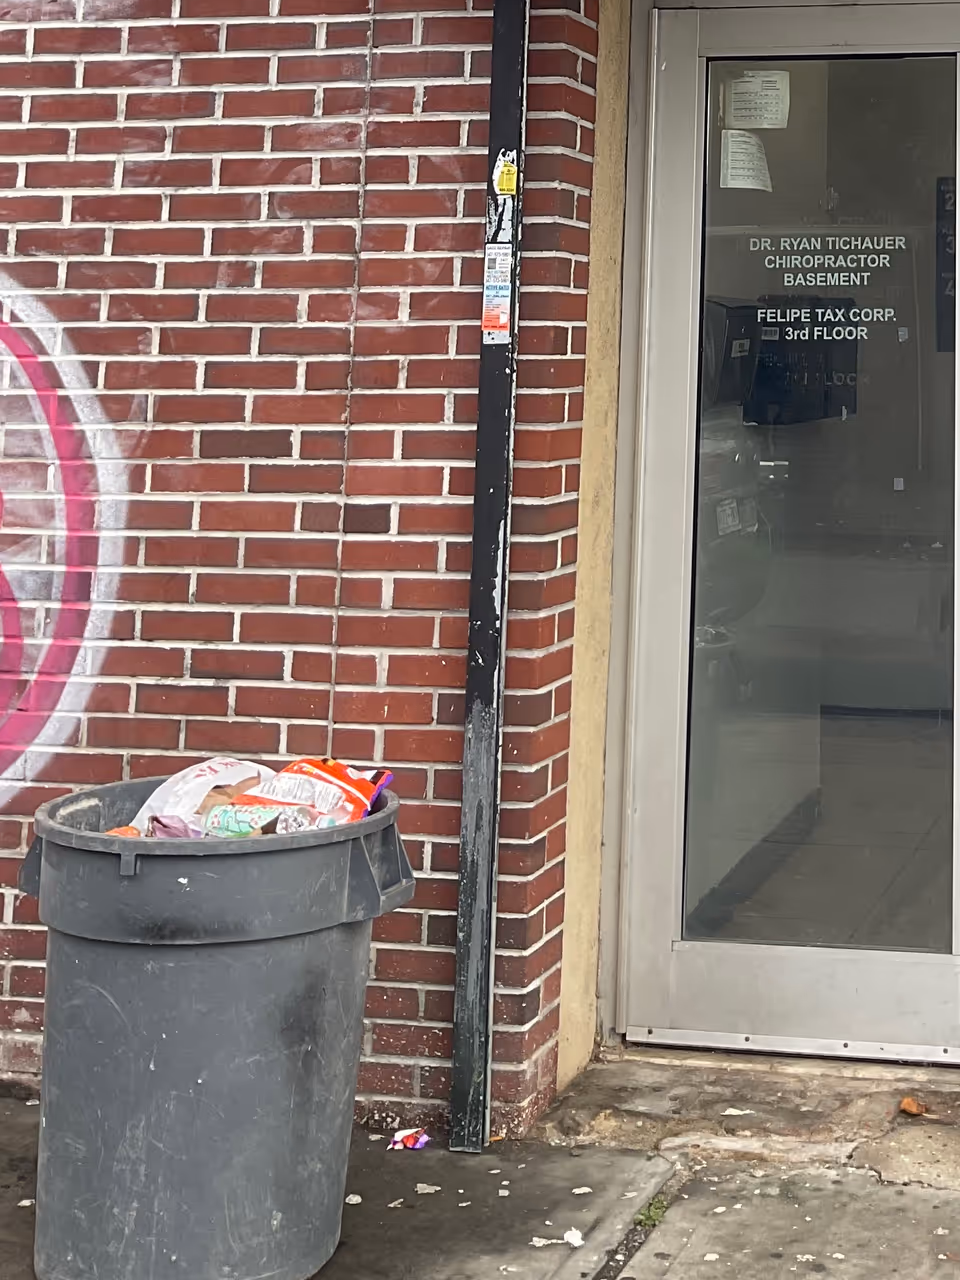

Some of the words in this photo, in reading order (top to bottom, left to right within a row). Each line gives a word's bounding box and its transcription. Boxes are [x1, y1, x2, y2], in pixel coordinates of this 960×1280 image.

[749, 237, 775, 251] DR.
[780, 237, 821, 251] RYAN
[825, 236, 906, 250] TICHAUER
[764, 254, 891, 268] CHIROPRACTOR
[783, 272, 871, 286] BASEMENT
[757, 309, 811, 322] FELIPE
[815, 308, 846, 322] TAX
[849, 308, 897, 322] CORP.
[785, 326, 809, 340] 3rd
[813, 326, 868, 340] FLOOR
